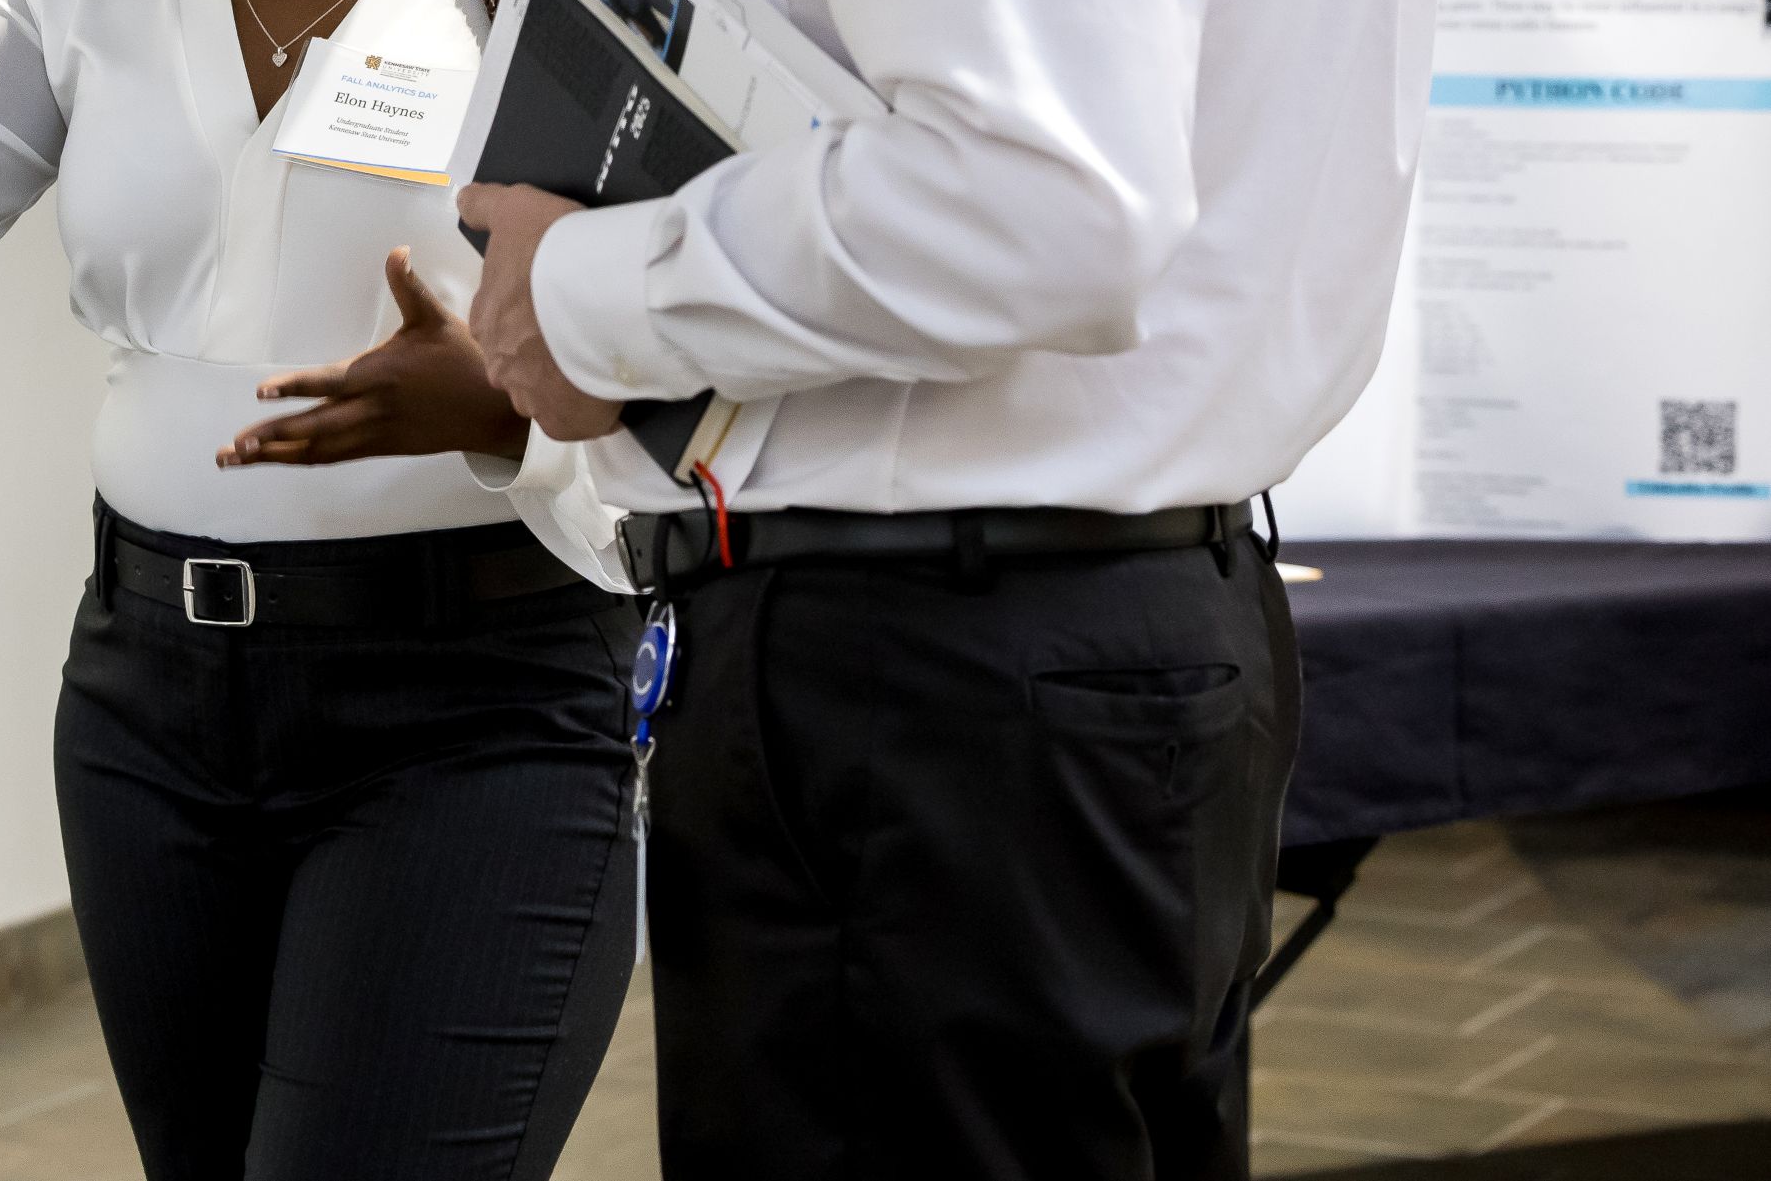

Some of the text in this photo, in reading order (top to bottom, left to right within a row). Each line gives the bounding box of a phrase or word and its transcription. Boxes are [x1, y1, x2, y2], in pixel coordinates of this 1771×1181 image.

[341, 75, 437, 100] FALL ANALYTICS DAY
[334, 92, 425, 120] Elon Haynes
[329, 124, 410, 146] Kennesaw State University
[336, 117, 409, 137] Undergraduate Student
